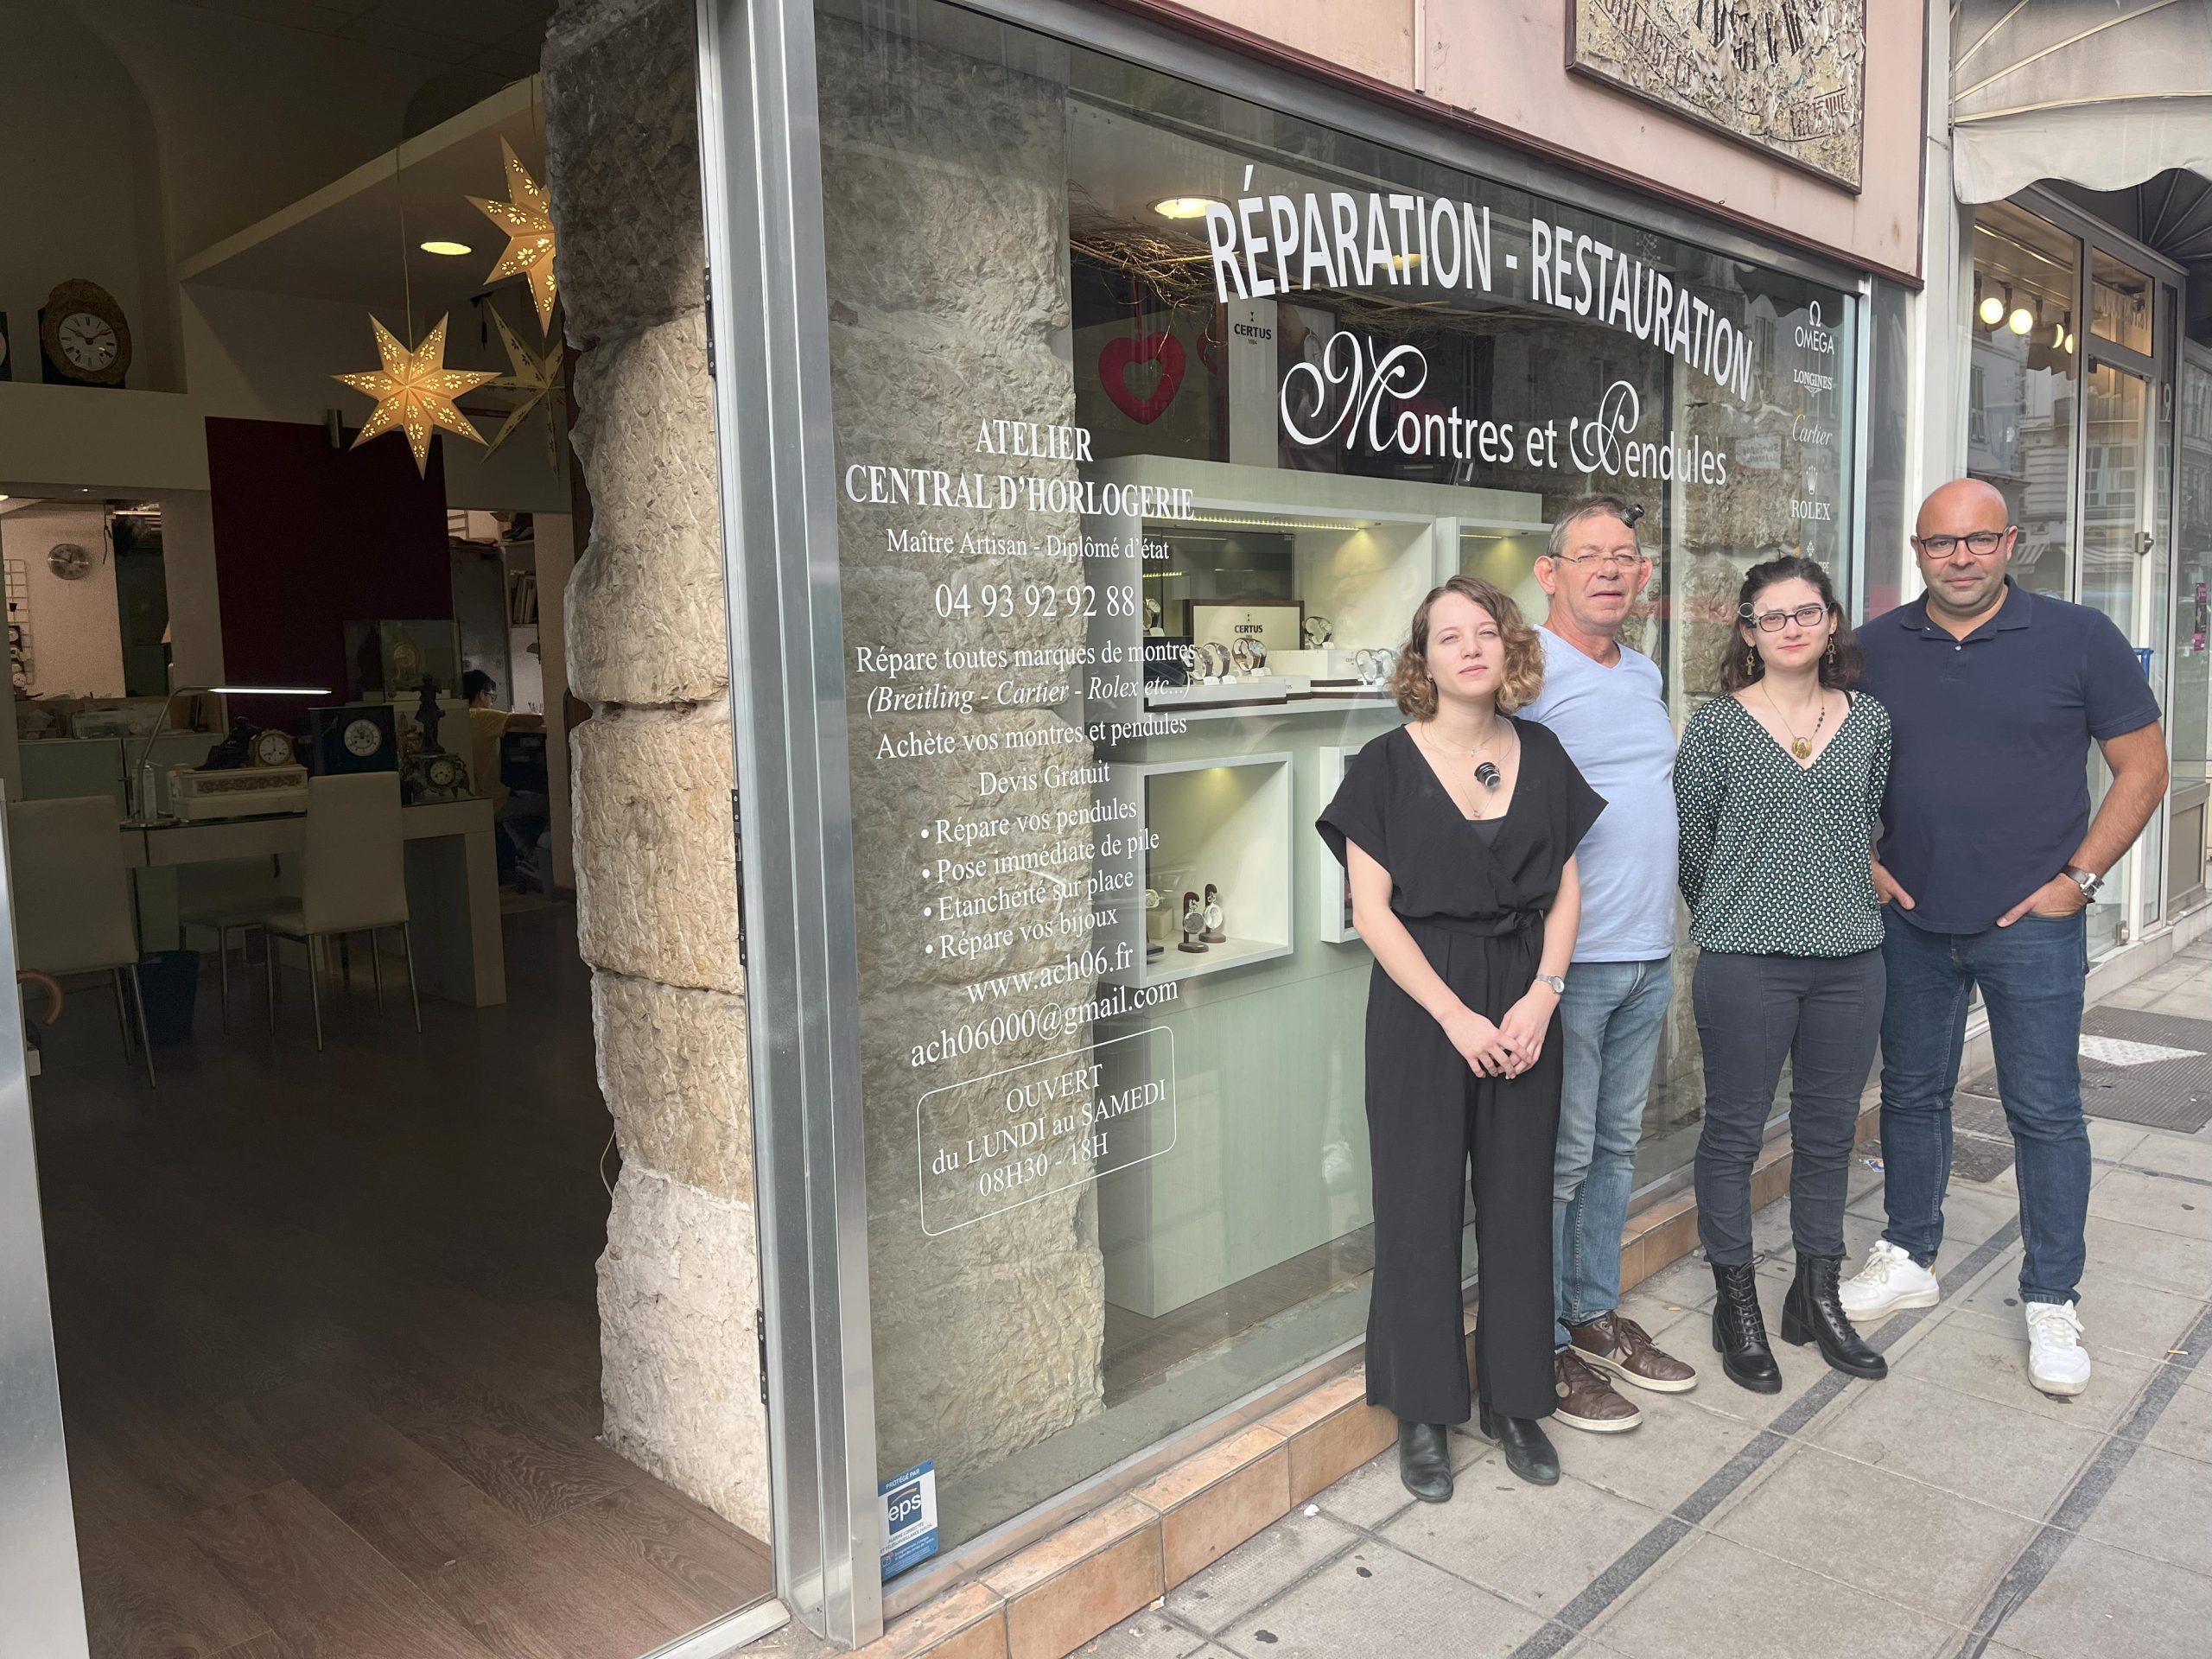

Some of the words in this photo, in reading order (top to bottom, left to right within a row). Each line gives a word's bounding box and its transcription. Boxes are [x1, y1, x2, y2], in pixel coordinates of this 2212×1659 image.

[1206, 164, 1492, 303] RÉPARATION
[1505, 254, 1518, 270] -
[1531, 218, 1754, 403] RESTAURATION
[1234, 323, 1272, 340] CERTUS
[1794, 326, 1834, 355] OMEGA
[1793, 369, 1833, 391] LONGINES
[1281, 330, 1515, 464] Montres
[1526, 419, 1558, 469] et
[1570, 379, 1728, 486] Pendules
[1792, 414, 1833, 446] Cartier
[976, 417, 1094, 462] ATELIER
[845, 464, 993, 510] CENTRAL
[1790, 499, 1831, 521] ROLEX
[887, 528, 954, 554] Maître
[959, 532, 1027, 556] Artisan
[1046, 535, 1120, 563] Diplômé
[935, 584, 971, 618] 04
[982, 585, 1014, 618] 93
[1025, 585, 1057, 617] 92
[1067, 585, 1097, 617] 92
[1106, 585, 1135, 616] 88
[1234, 625, 1263, 633] CERTUS
[855, 646, 938, 679] Répare
[944, 645, 1007, 670] toutes
[1014, 645, 1096, 672] marques
[1101, 640, 1122, 664] de
[1128, 640, 1196, 662] montres
[866, 682, 975, 719] (Breitling
[996, 680, 1070, 707] Cartier
[1087, 676, 1139, 701] Rolex
[1144, 675, 1192, 701] etc...)
[875, 729, 956, 760] Achète
[962, 733, 999, 753] vos
[1005, 722, 1084, 749] montres
[1089, 720, 1107, 741] et
[1110, 712, 1188, 746] pendules
[979, 767, 1038, 797] Devis
[1044, 760, 1111, 790] Gratuit
[935, 811, 1010, 848] Répare
[1016, 813, 1051, 832] vos
[1056, 798, 1138, 836] pendules
[937, 856, 987, 884] Pose
[994, 838, 1096, 875] immédiate
[1101, 834, 1122, 857] de
[1127, 829, 1160, 862] pile
[938, 883, 1046, 922] Etanchéité
[1052, 879, 1082, 901] sur
[1086, 871, 1135, 899] place
[939, 924, 1014, 960] Répare
[1019, 919, 1054, 941] vos
[1059, 908, 1118, 938] bijoux
[965, 942, 1134, 1005] www.ach06.fr
[911, 980, 1179, 1067] ach06000@gmail.com
[1006, 1064, 1103, 1113] OUVERT
[931, 1147, 960, 1176] du
[966, 1118, 1046, 1166] LUNDI
[1052, 1111, 1074, 1136] au
[1081, 1079, 1166, 1127] SAMEDI
[979, 1153, 1048, 1197] 08H30
[1070, 1133, 1109, 1166] 18H
[886, 1472, 909, 1490] PROTÉGÉ
[909, 1468, 920, 1478] PAR
[888, 1494, 921, 1522] eps
